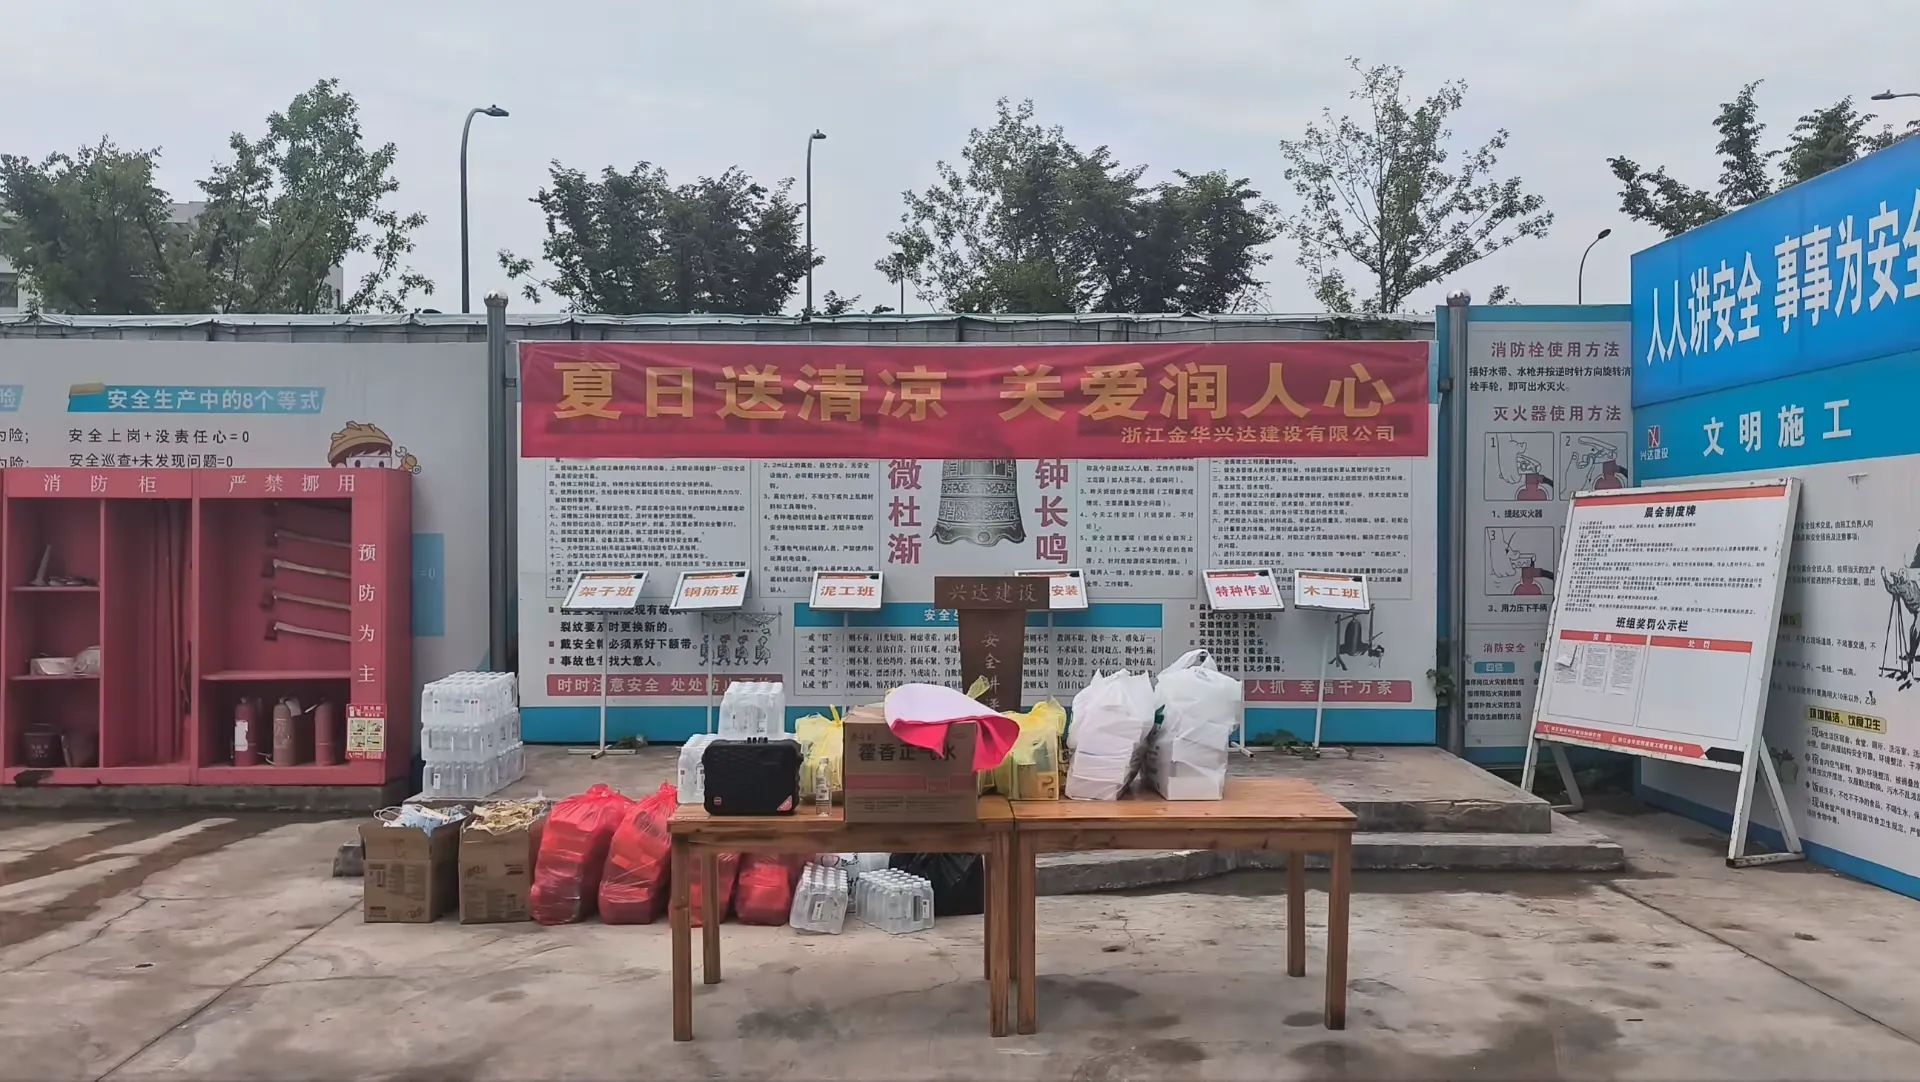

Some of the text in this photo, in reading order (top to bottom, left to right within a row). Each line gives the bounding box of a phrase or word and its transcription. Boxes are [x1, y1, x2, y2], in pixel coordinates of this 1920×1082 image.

[1647, 251, 1762, 366] 人人讲安全
[1491, 342, 1620, 358] 消防栓使用方法
[553, 361, 1396, 422] 夏日送清凉 关爱润人心
[107, 389, 320, 411] 安全生产中的8个等式
[1493, 405, 1622, 422] 灭火器使用方法
[68, 428, 250, 444] 安全上岗+没责任心=0
[1121, 425, 1396, 444] 浙江金华兴达建设有限公司
[1702, 399, 1852, 457] 文明施工
[1490, 437, 1496, 448] 1
[1565, 436, 1571, 447] 2
[43, 474, 157, 493] 消防柜
[228, 474, 356, 493] 严禁挪用
[1644, 505, 1697, 518] 晨会制度牌
[579, 586, 636, 597] 架子班
[683, 584, 739, 597] 钢筋班
[820, 586, 875, 597] 泥工班
[949, 582, 1038, 603] 兴达建设
[1051, 585, 1078, 596] 安装
[1215, 585, 1273, 597] 特种作业
[1304, 585, 1361, 599] 木工班
[358, 543, 376, 682] 预防为主
[1615, 616, 1689, 632] 班组奖罚公示栏
[1483, 642, 1526, 653] 消防安全
[858, 742, 957, 761] 藿香正水
